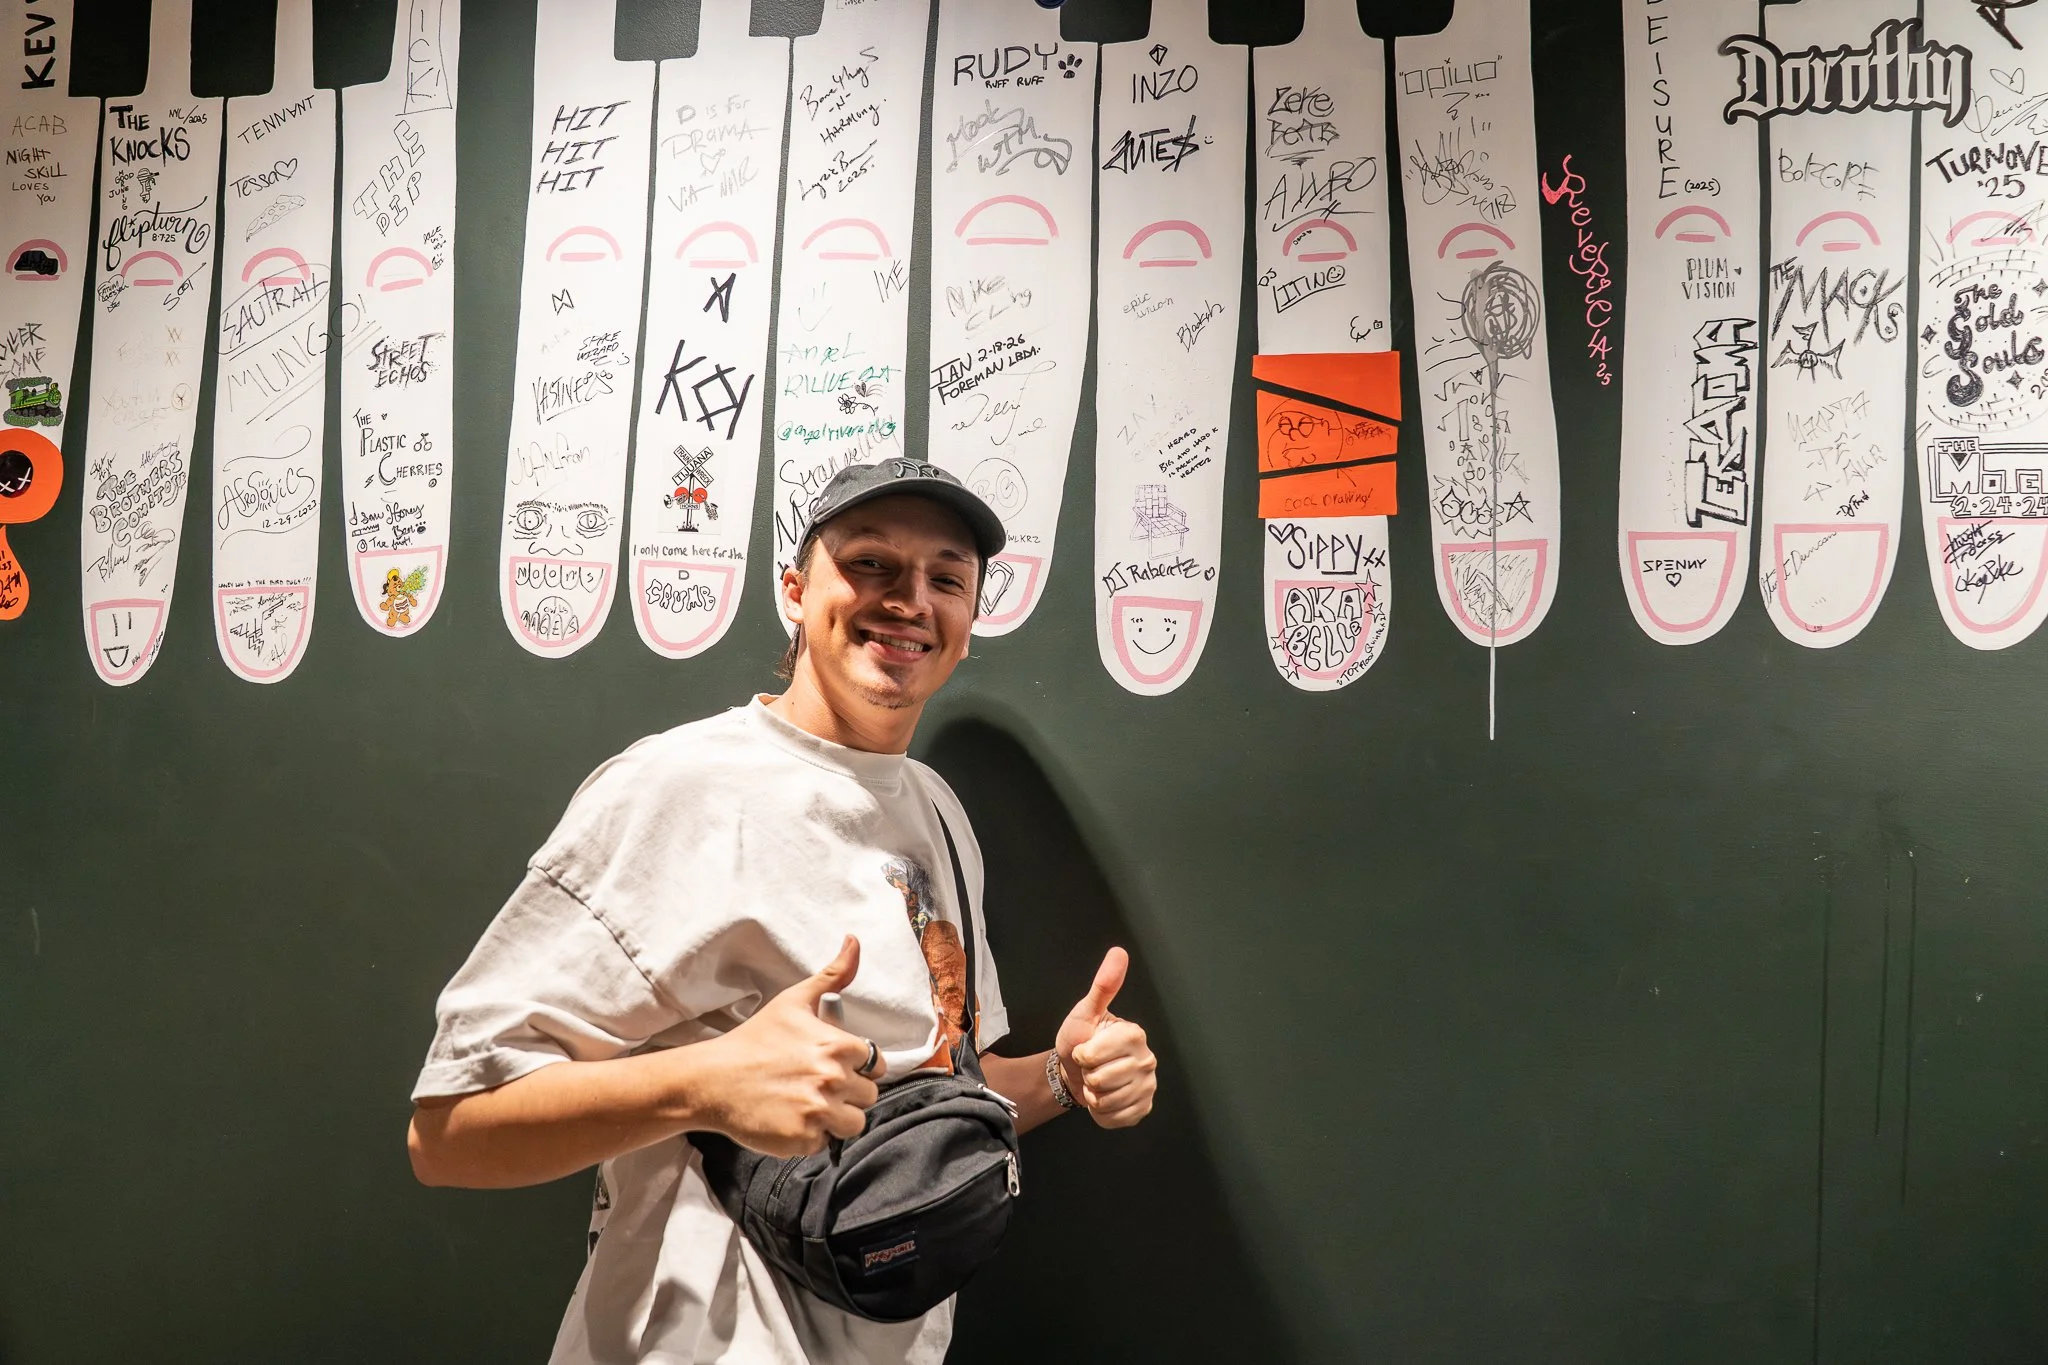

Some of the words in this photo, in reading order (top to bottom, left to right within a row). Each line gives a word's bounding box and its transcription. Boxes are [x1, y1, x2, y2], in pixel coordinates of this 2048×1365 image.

[21, 0, 56, 89] KEV
[953, 43, 1059, 86] RUDY
[1718, 17, 1973, 128] Dorothy
[985, 78, 1009, 89] RUFF
[1016, 76, 1045, 87] RUFF
[1132, 65, 1198, 104] INZO
[1647, 0, 1680, 199] EISURE
[12, 115, 67, 136] ACAB
[109, 105, 150, 130] THE
[551, 100, 631, 135] HIT
[540, 135, 619, 165] HIT
[12, 182, 49, 192] LOVES
[536, 166, 605, 194] HIT
[376, 171, 421, 236] DIP
[1686, 258, 1729, 281] PLUM
[1681, 281, 1736, 300] VISION
[978, 333, 1026, 362] 2-18-26
[938, 358, 1003, 406] FOREMAN
[1938, 441, 1976, 451] THE
[378, 452, 443, 486] CHERRIES
[675, 450, 711, 481] TIJUANA
[1938, 452, 2048, 495] MOTE
[640, 545, 659, 561] only
[662, 545, 688, 558] come
